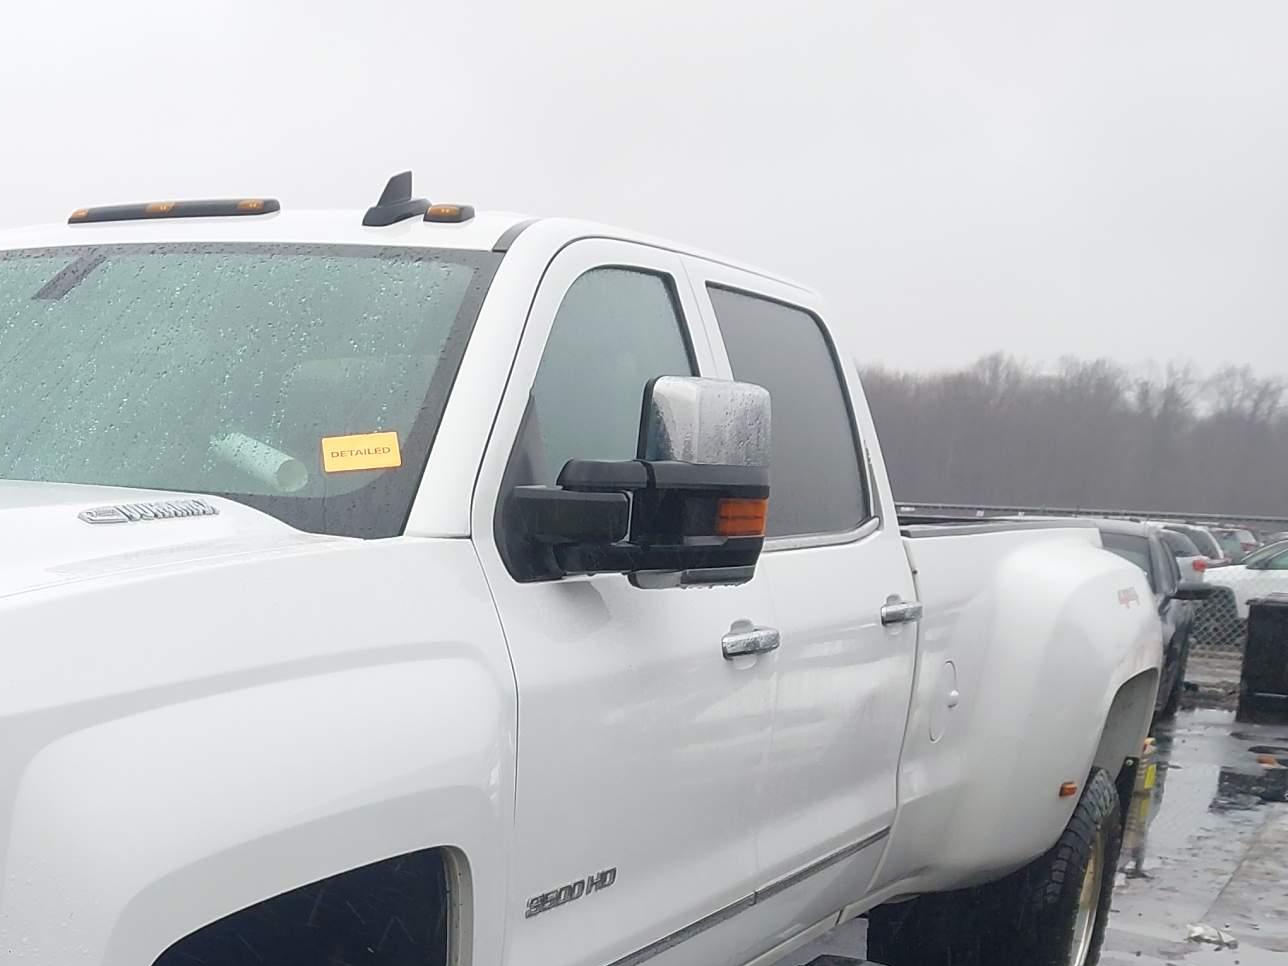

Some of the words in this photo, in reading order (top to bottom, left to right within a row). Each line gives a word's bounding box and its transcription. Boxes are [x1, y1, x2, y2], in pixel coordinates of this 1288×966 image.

[331, 446, 391, 458] DETAILED
[525, 879, 585, 919] 3500
[585, 866, 617, 896] HD
